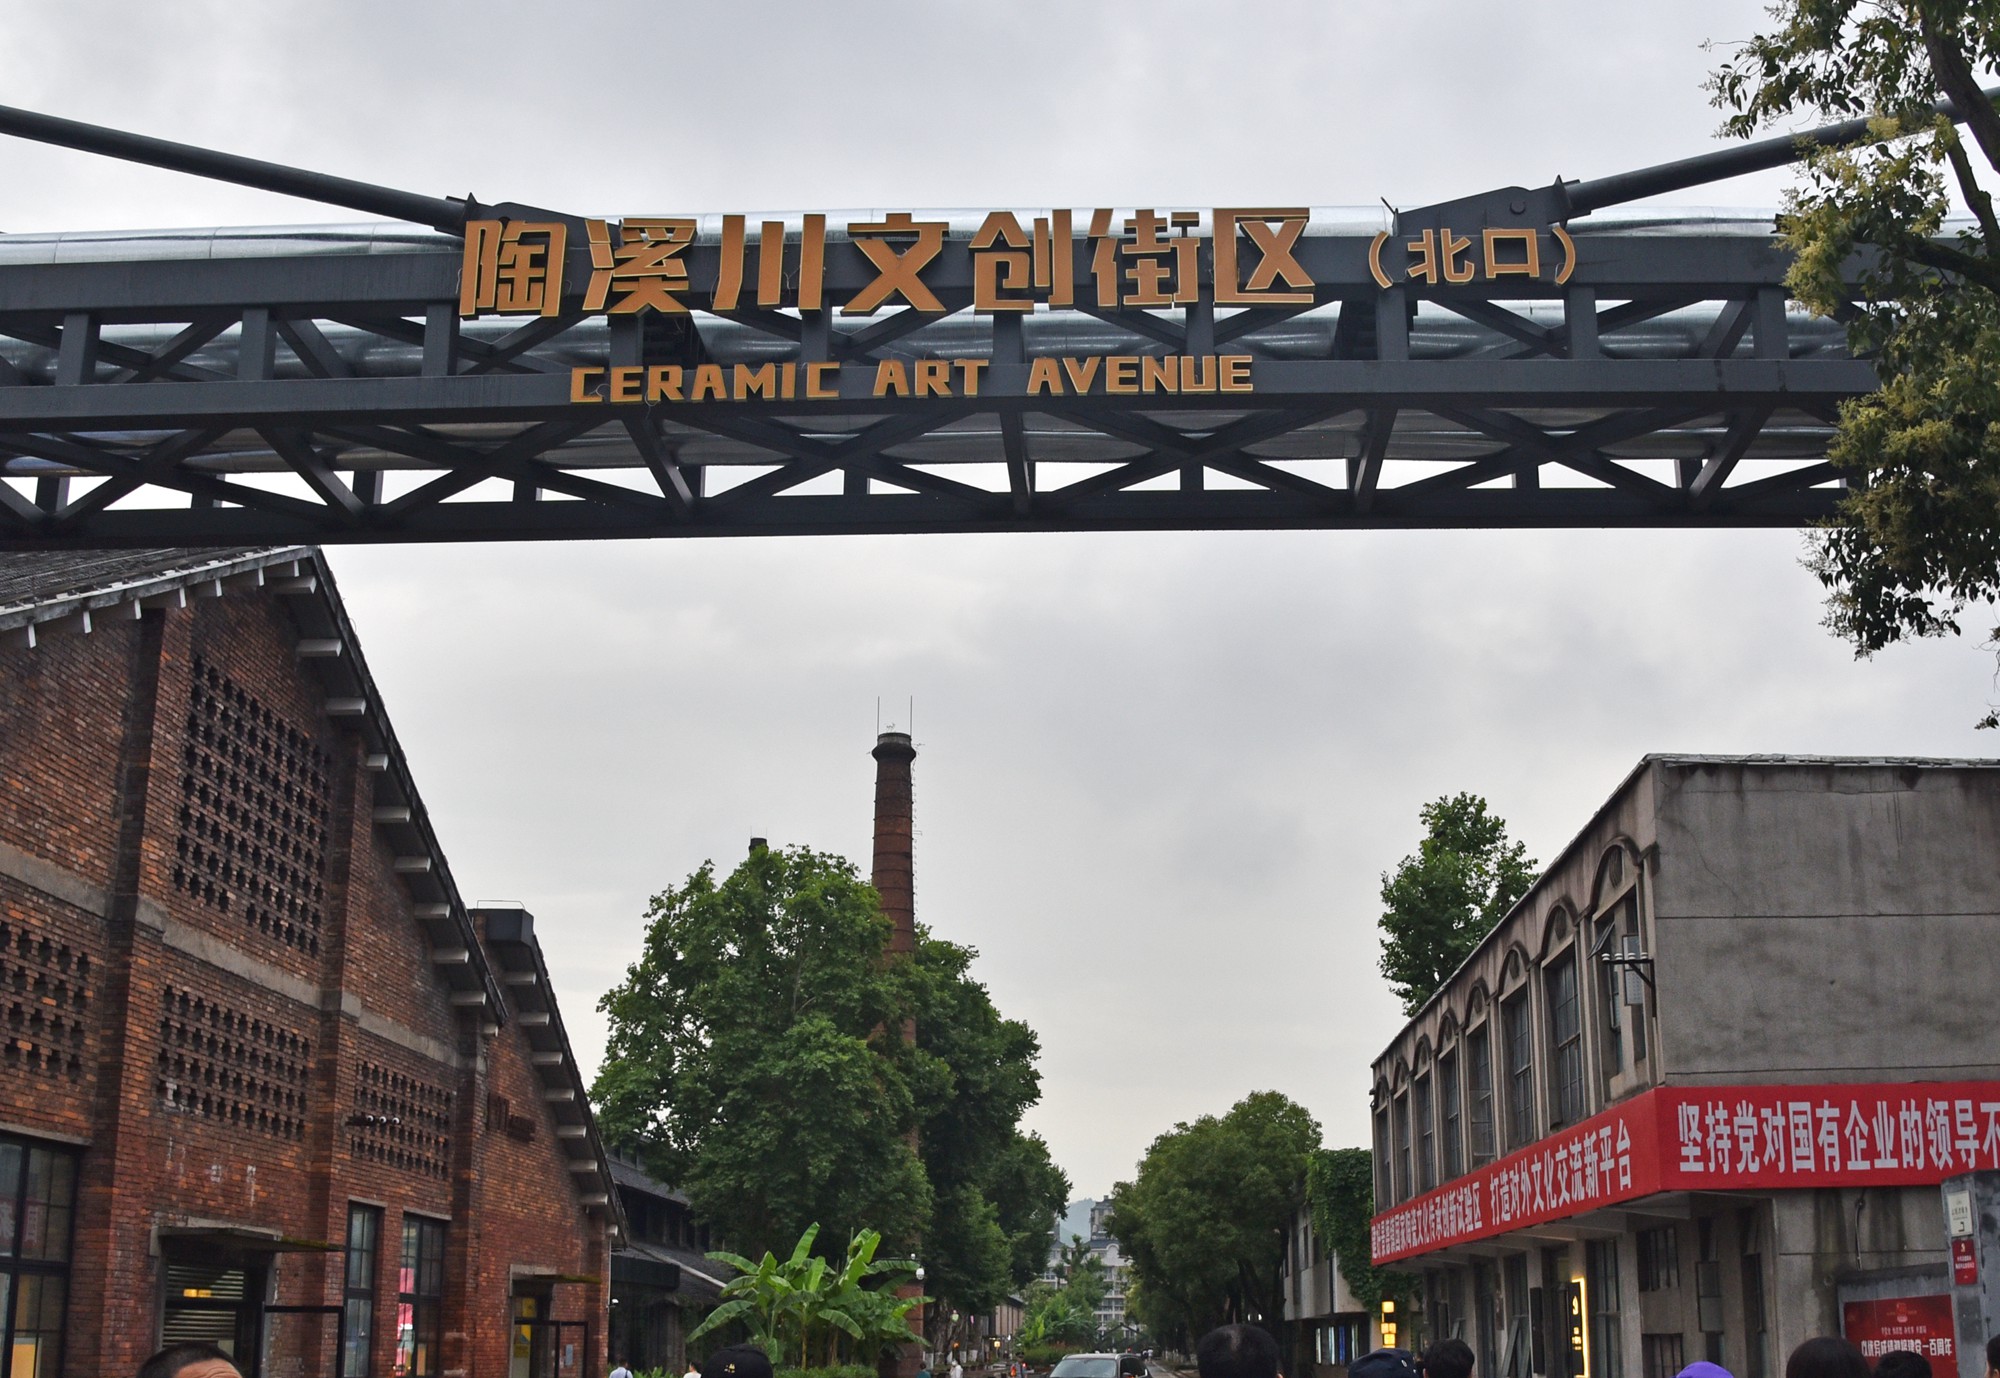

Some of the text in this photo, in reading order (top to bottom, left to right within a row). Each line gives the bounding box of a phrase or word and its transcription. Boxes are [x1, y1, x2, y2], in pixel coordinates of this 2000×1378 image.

[459, 207, 1315, 320] 陶溪川文创街区
[570, 355, 1254, 404] CERAMIC ART AVENUE
[1490, 1117, 1632, 1226] 打造对外文化交流新平台
[1678, 1096, 2000, 1175] 坚持党对国有企业的领导不
